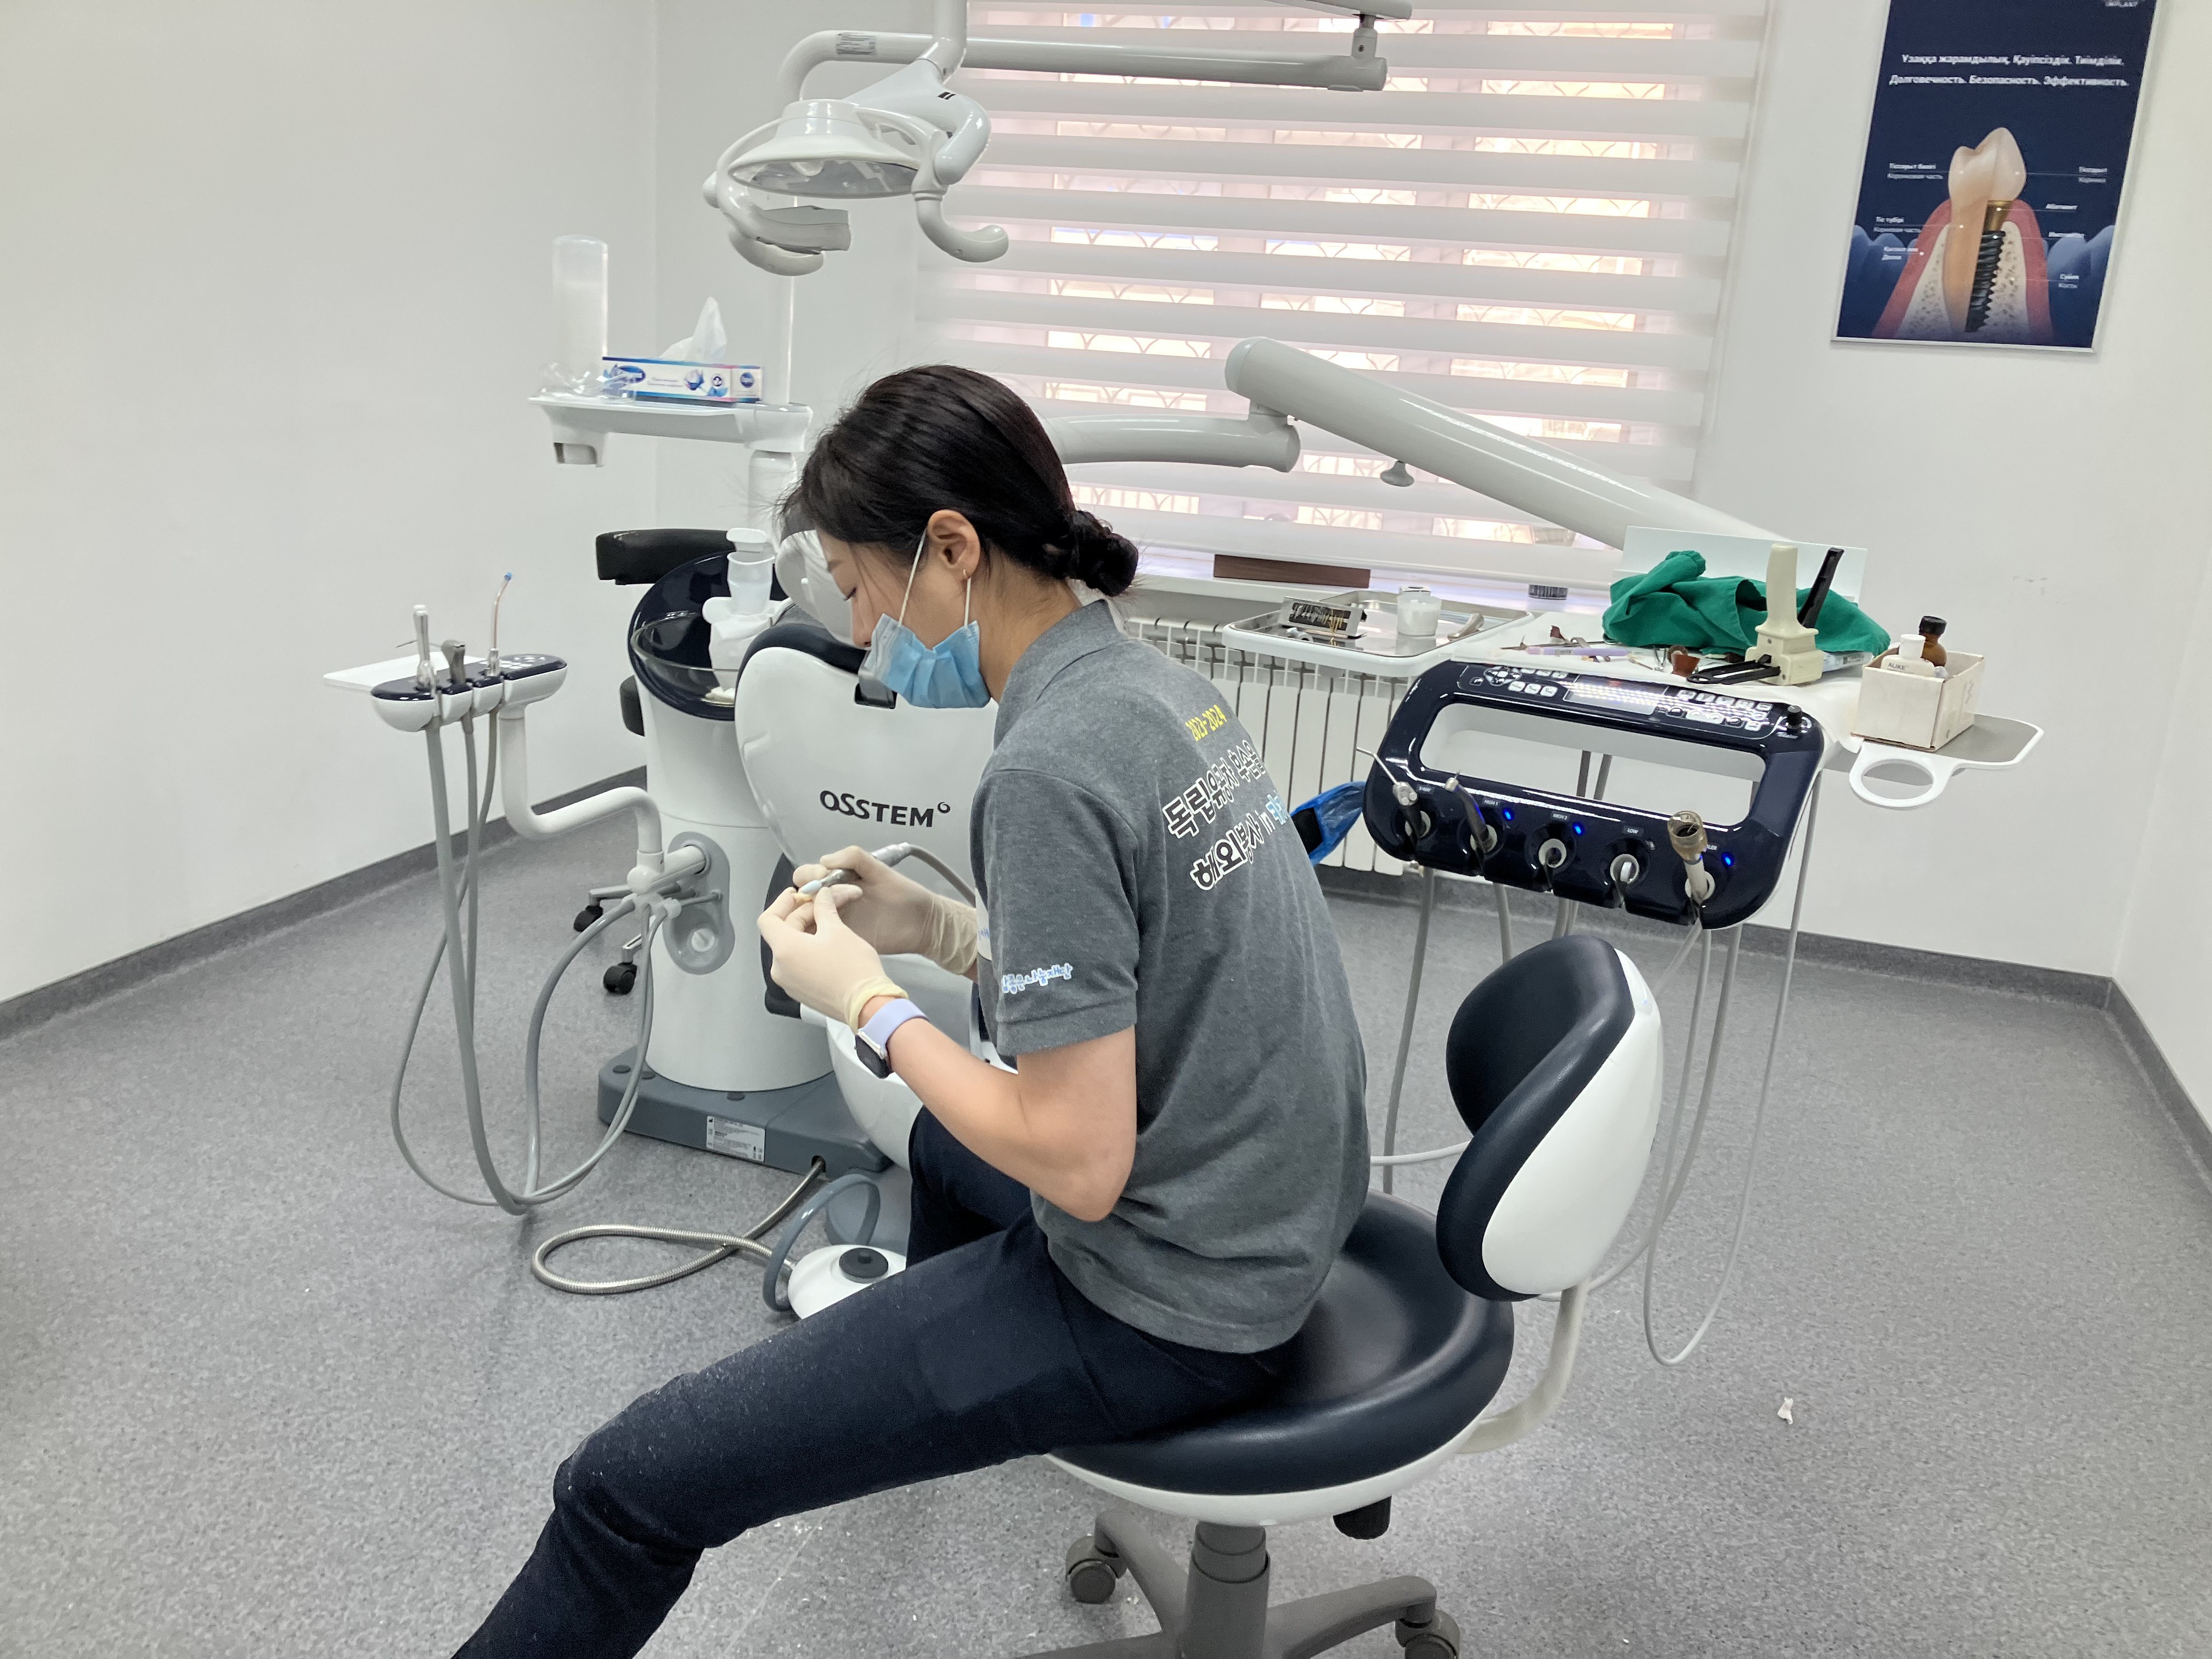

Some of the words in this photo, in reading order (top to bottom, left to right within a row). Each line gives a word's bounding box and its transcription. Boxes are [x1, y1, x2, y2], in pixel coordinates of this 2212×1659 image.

[1185, 704, 1227, 742] 2023-2024
[820, 790, 934, 827] OSSTEM
[1163, 757, 1240, 839] 독립유공자
[1190, 812, 1265, 890] 해외봉사
[1254, 810, 1276, 835] in
